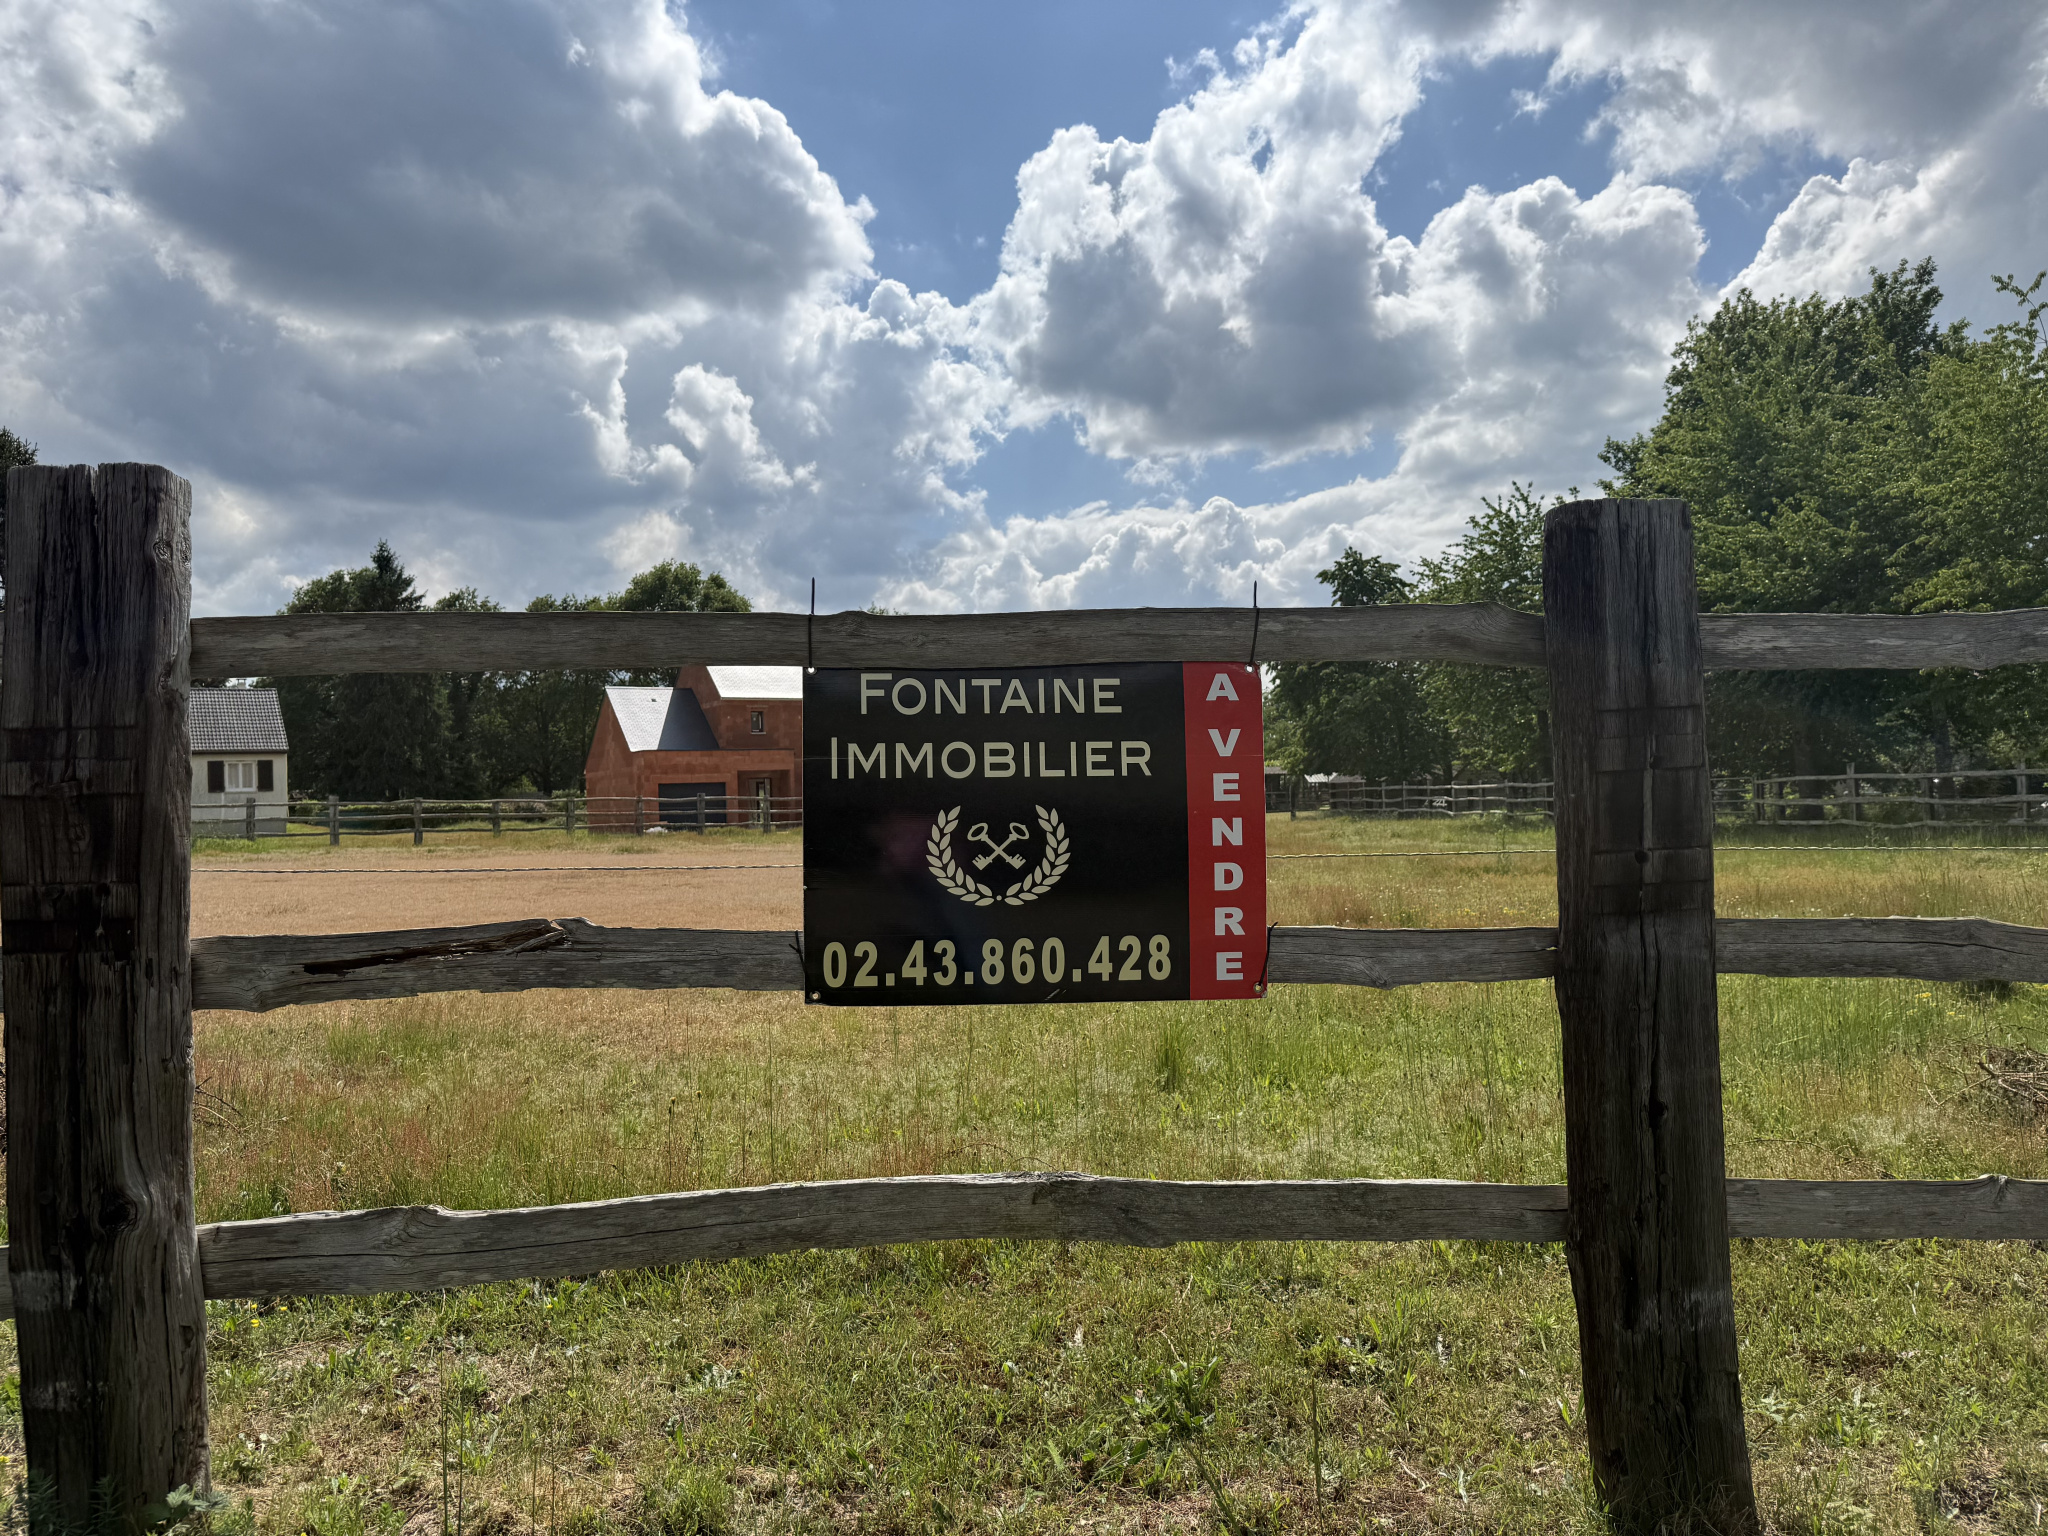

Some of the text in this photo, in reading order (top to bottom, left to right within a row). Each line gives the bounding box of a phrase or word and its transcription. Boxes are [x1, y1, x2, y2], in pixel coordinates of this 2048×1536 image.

[860, 672, 1123, 716] FONTAINE
[831, 736, 1153, 780] IMMOBILIER
[822, 934, 1172, 988] 02.43.860.428
